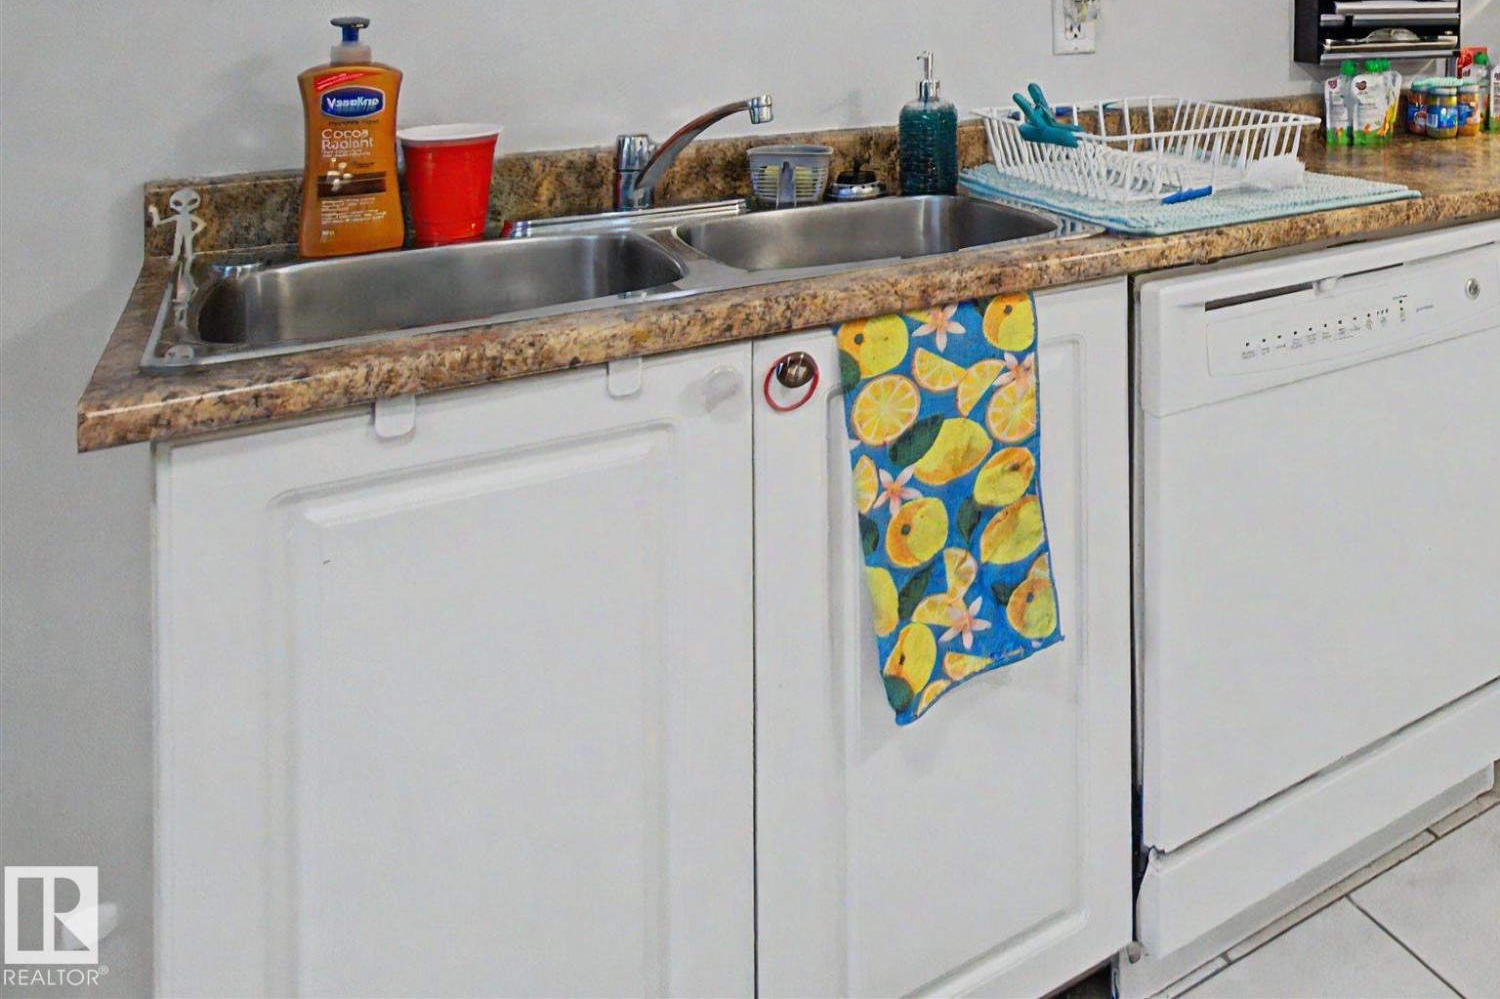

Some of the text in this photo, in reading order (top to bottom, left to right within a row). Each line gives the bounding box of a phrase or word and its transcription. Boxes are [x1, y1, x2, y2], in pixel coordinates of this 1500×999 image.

[326, 96, 380, 112] Vaseline
[321, 129, 370, 140] Cocoa
[321, 138, 375, 150] Radiant
